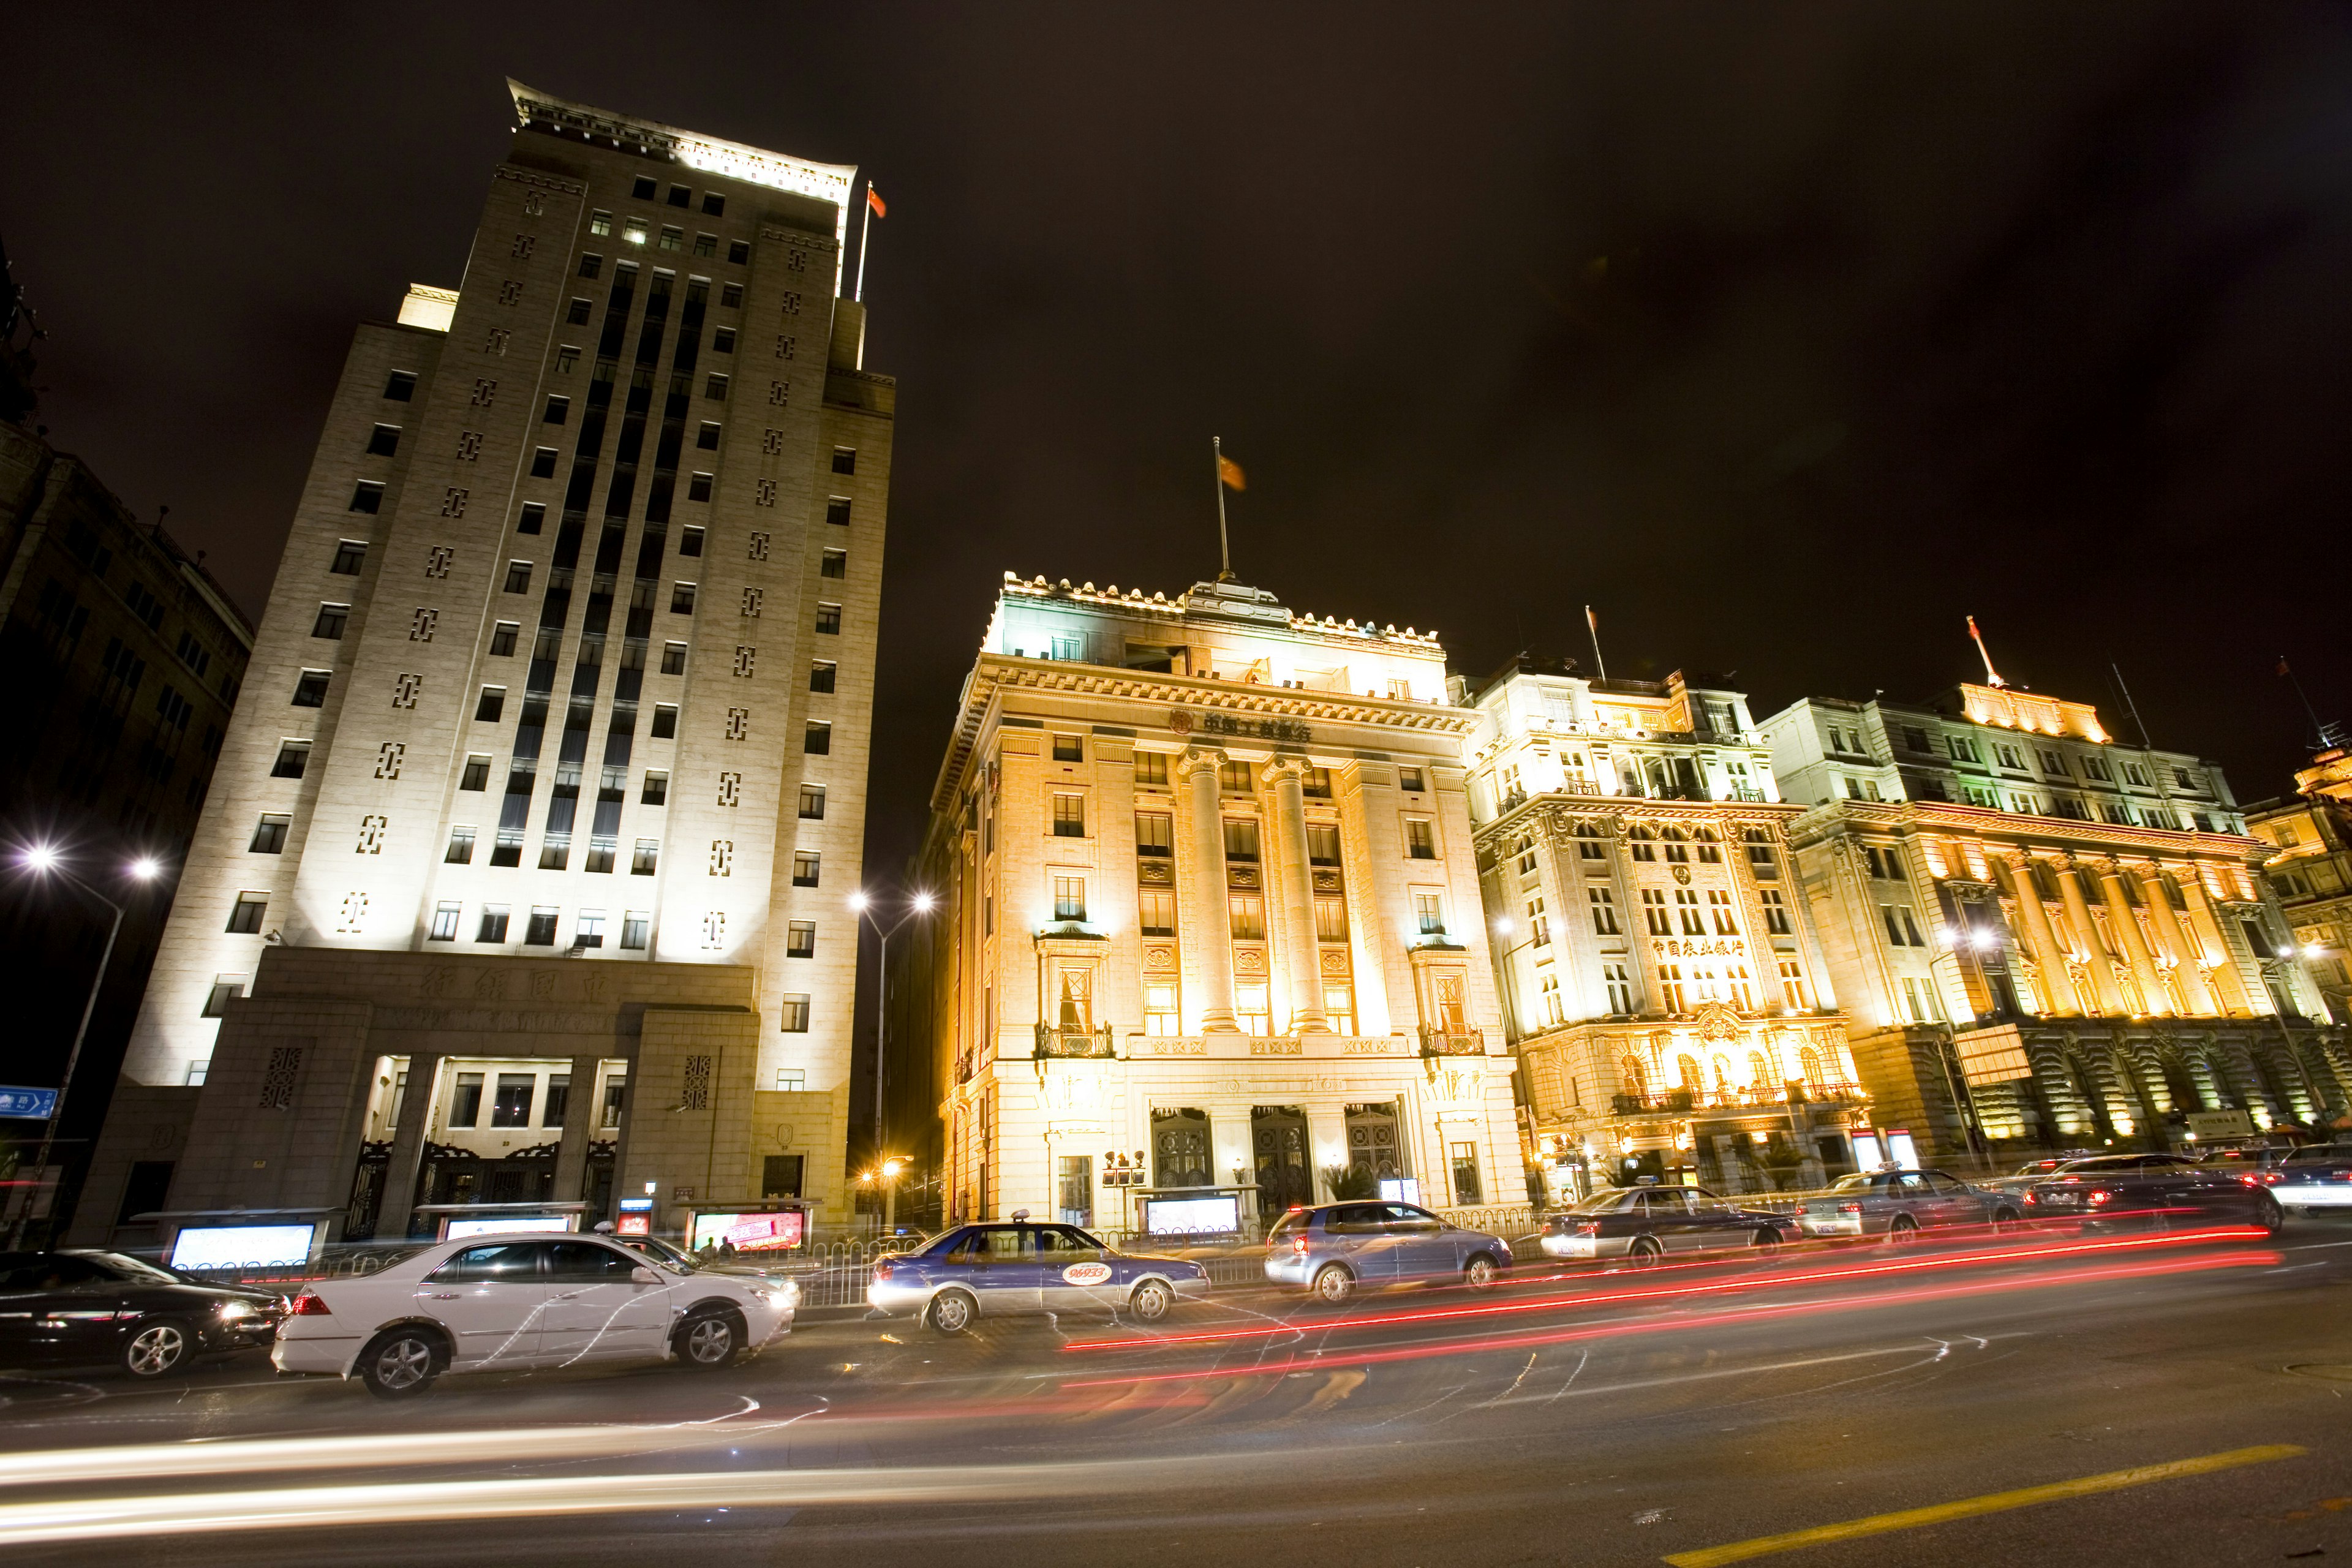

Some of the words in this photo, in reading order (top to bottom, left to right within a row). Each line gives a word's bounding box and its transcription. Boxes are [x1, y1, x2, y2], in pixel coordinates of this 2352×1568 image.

[1204, 717, 1312, 743] 中国工商银行
[1653, 938, 1745, 960] 中国农业银行
[1697, 1123, 1740, 1132] AGRICULTURAL
[1068, 1267, 1105, 1278] 96933
